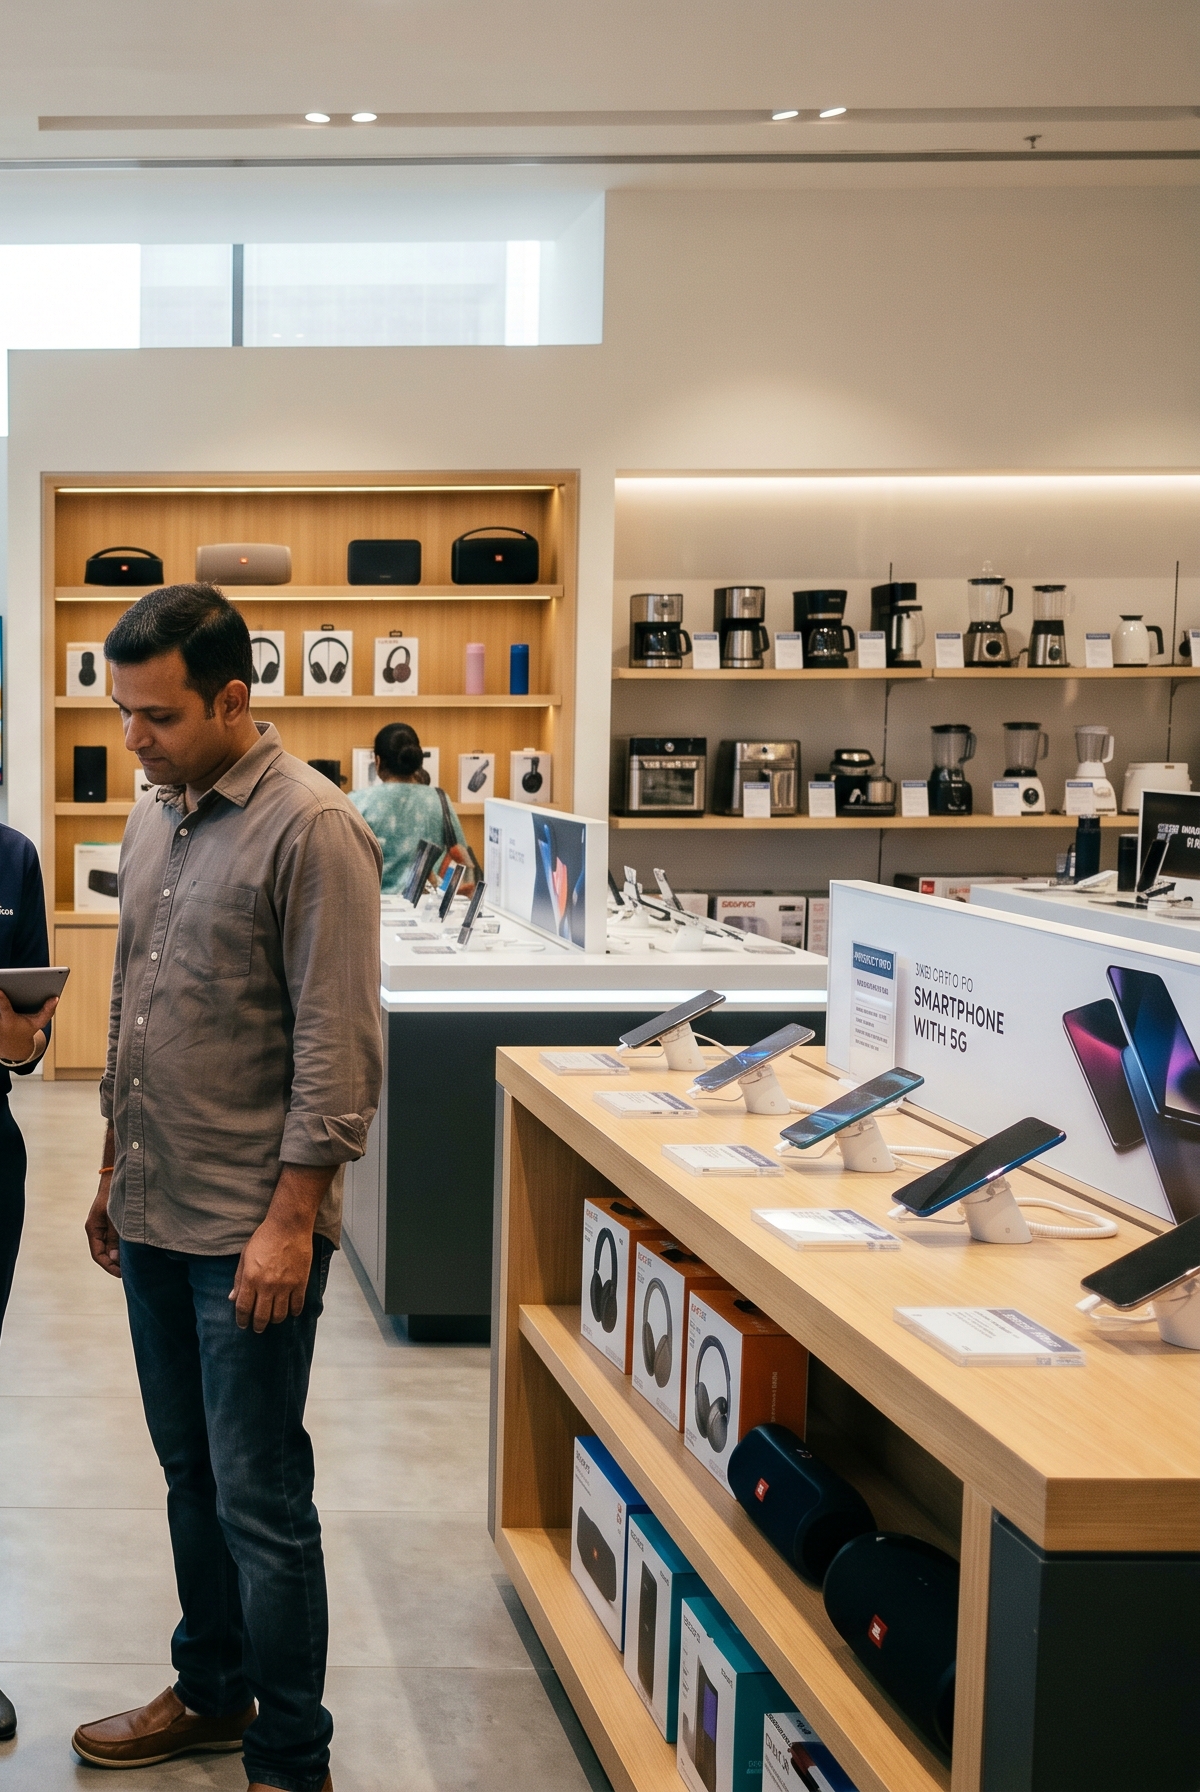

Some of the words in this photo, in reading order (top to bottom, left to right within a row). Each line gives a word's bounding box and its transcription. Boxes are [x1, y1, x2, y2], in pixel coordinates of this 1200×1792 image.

[914, 986, 1004, 1035] SMARTPHONE
[913, 1015, 946, 1046] WITH
[950, 1028, 967, 1053] 5G
